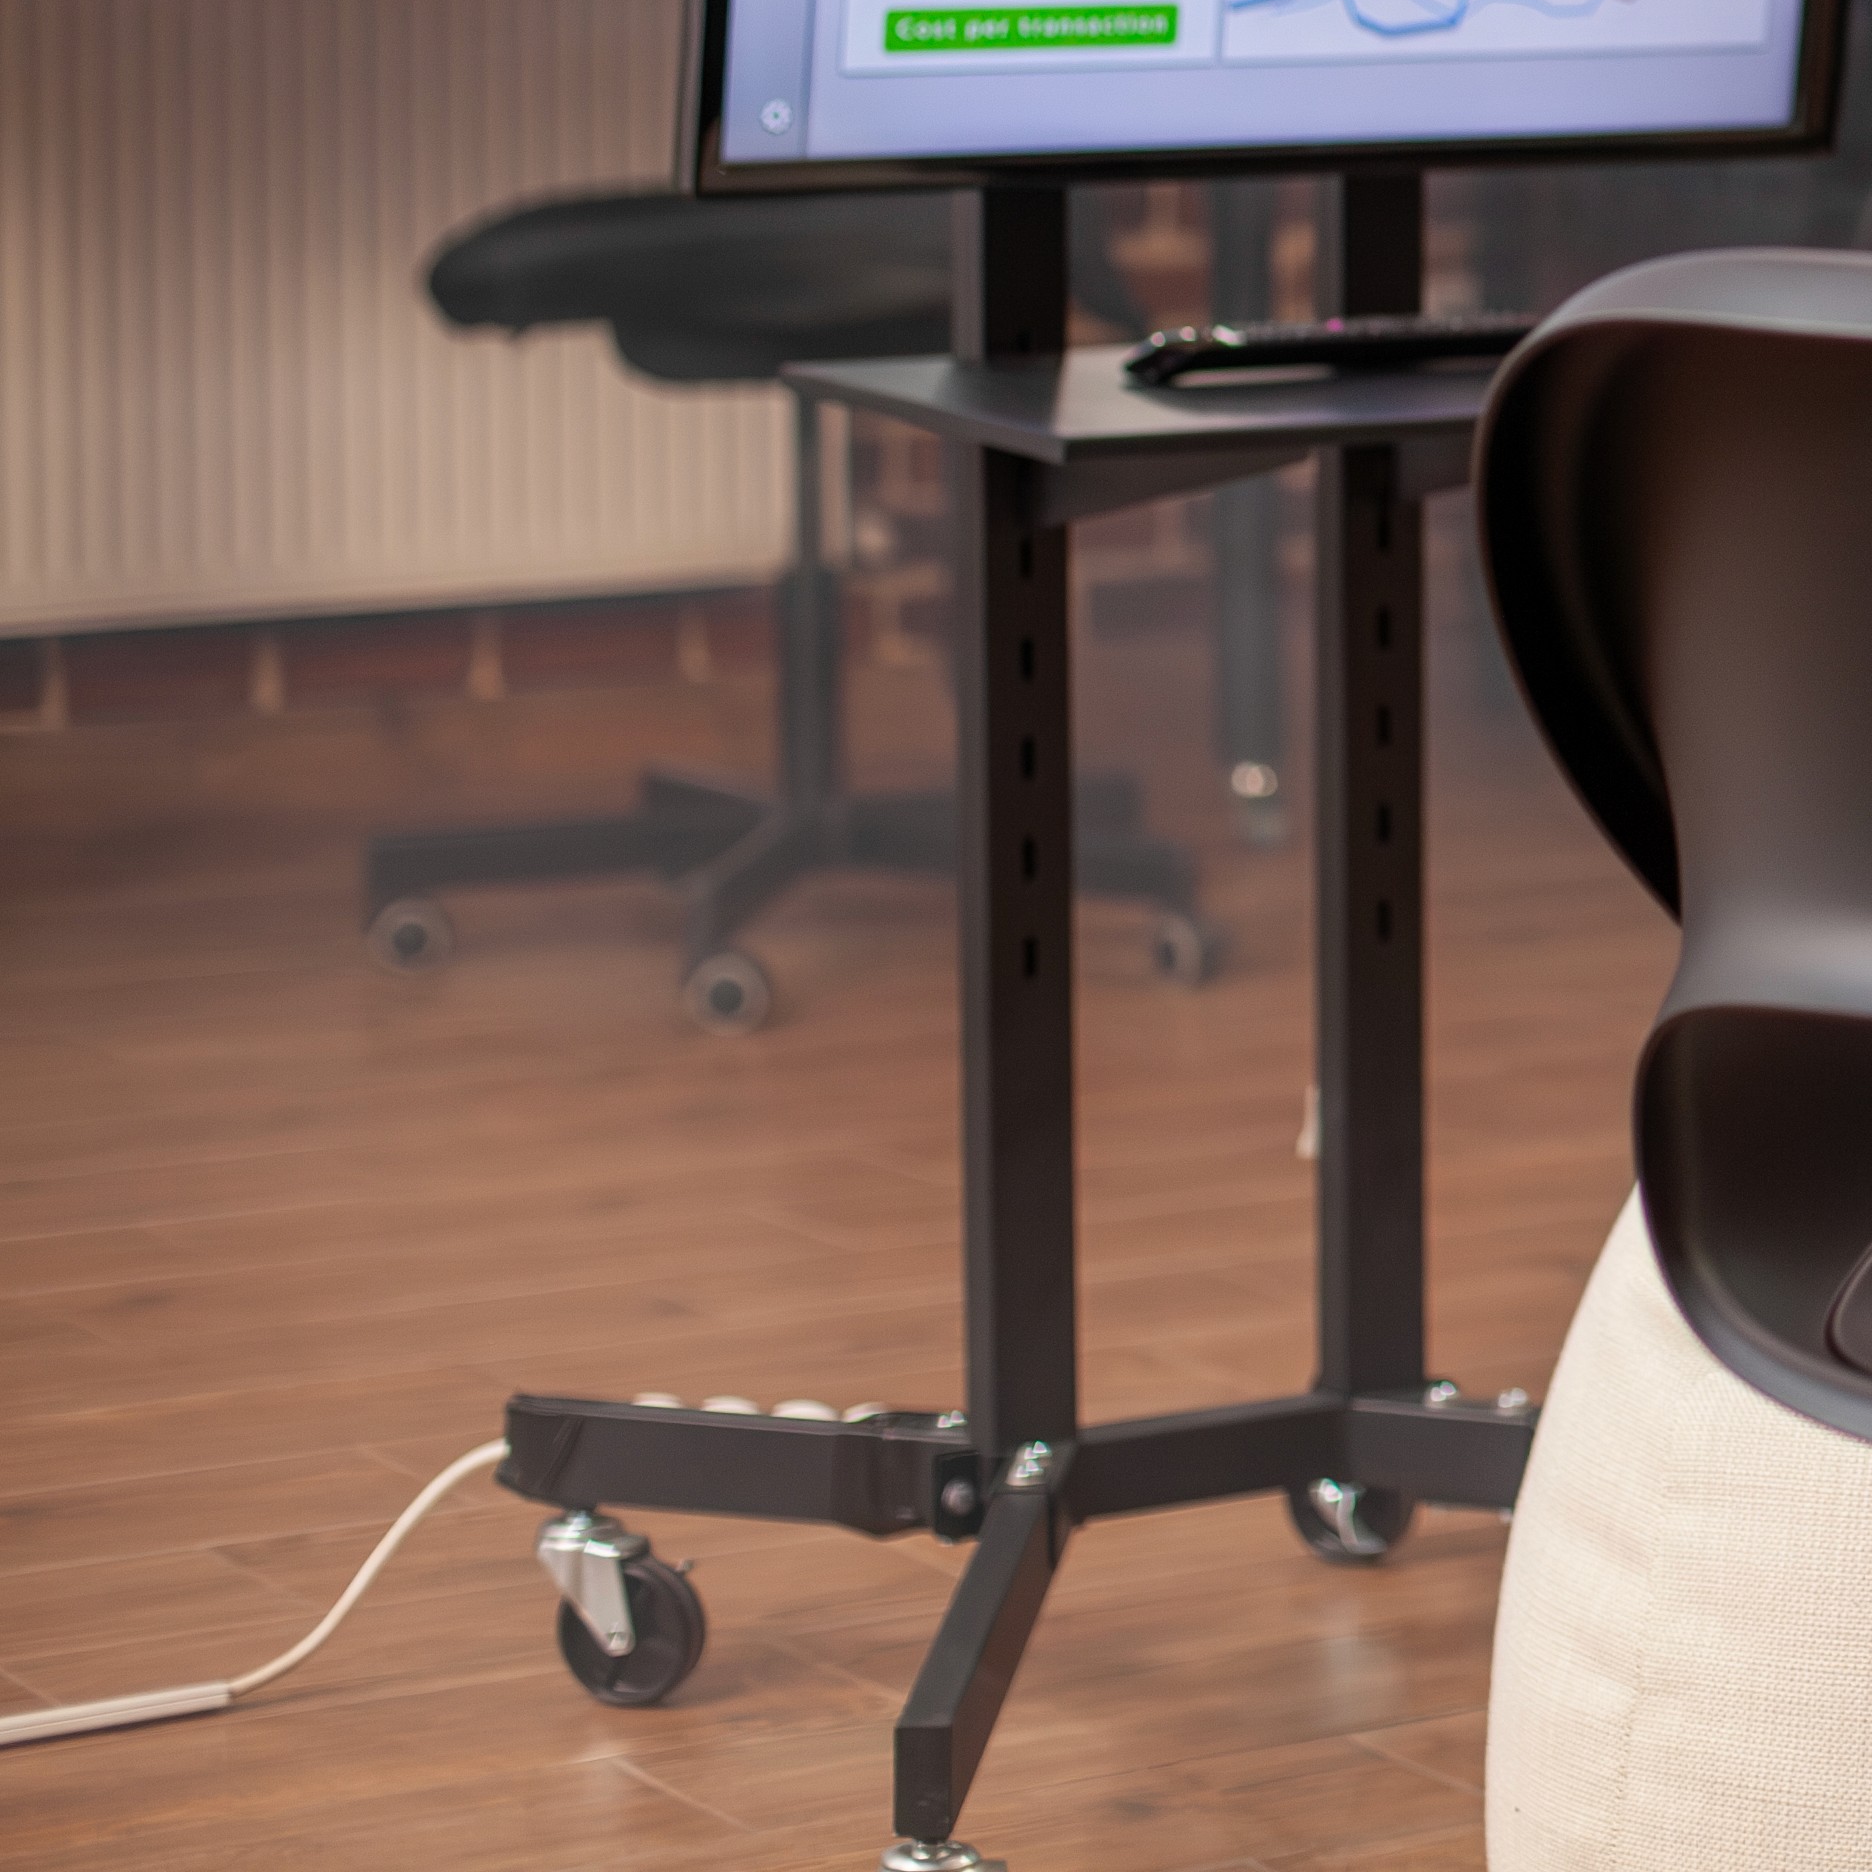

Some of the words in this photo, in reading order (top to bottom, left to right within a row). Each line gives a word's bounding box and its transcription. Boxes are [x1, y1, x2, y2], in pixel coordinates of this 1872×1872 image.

[895, 15, 956, 42] Cost
[964, 18, 1011, 44] per
[1017, 12, 1170, 40] transaction
